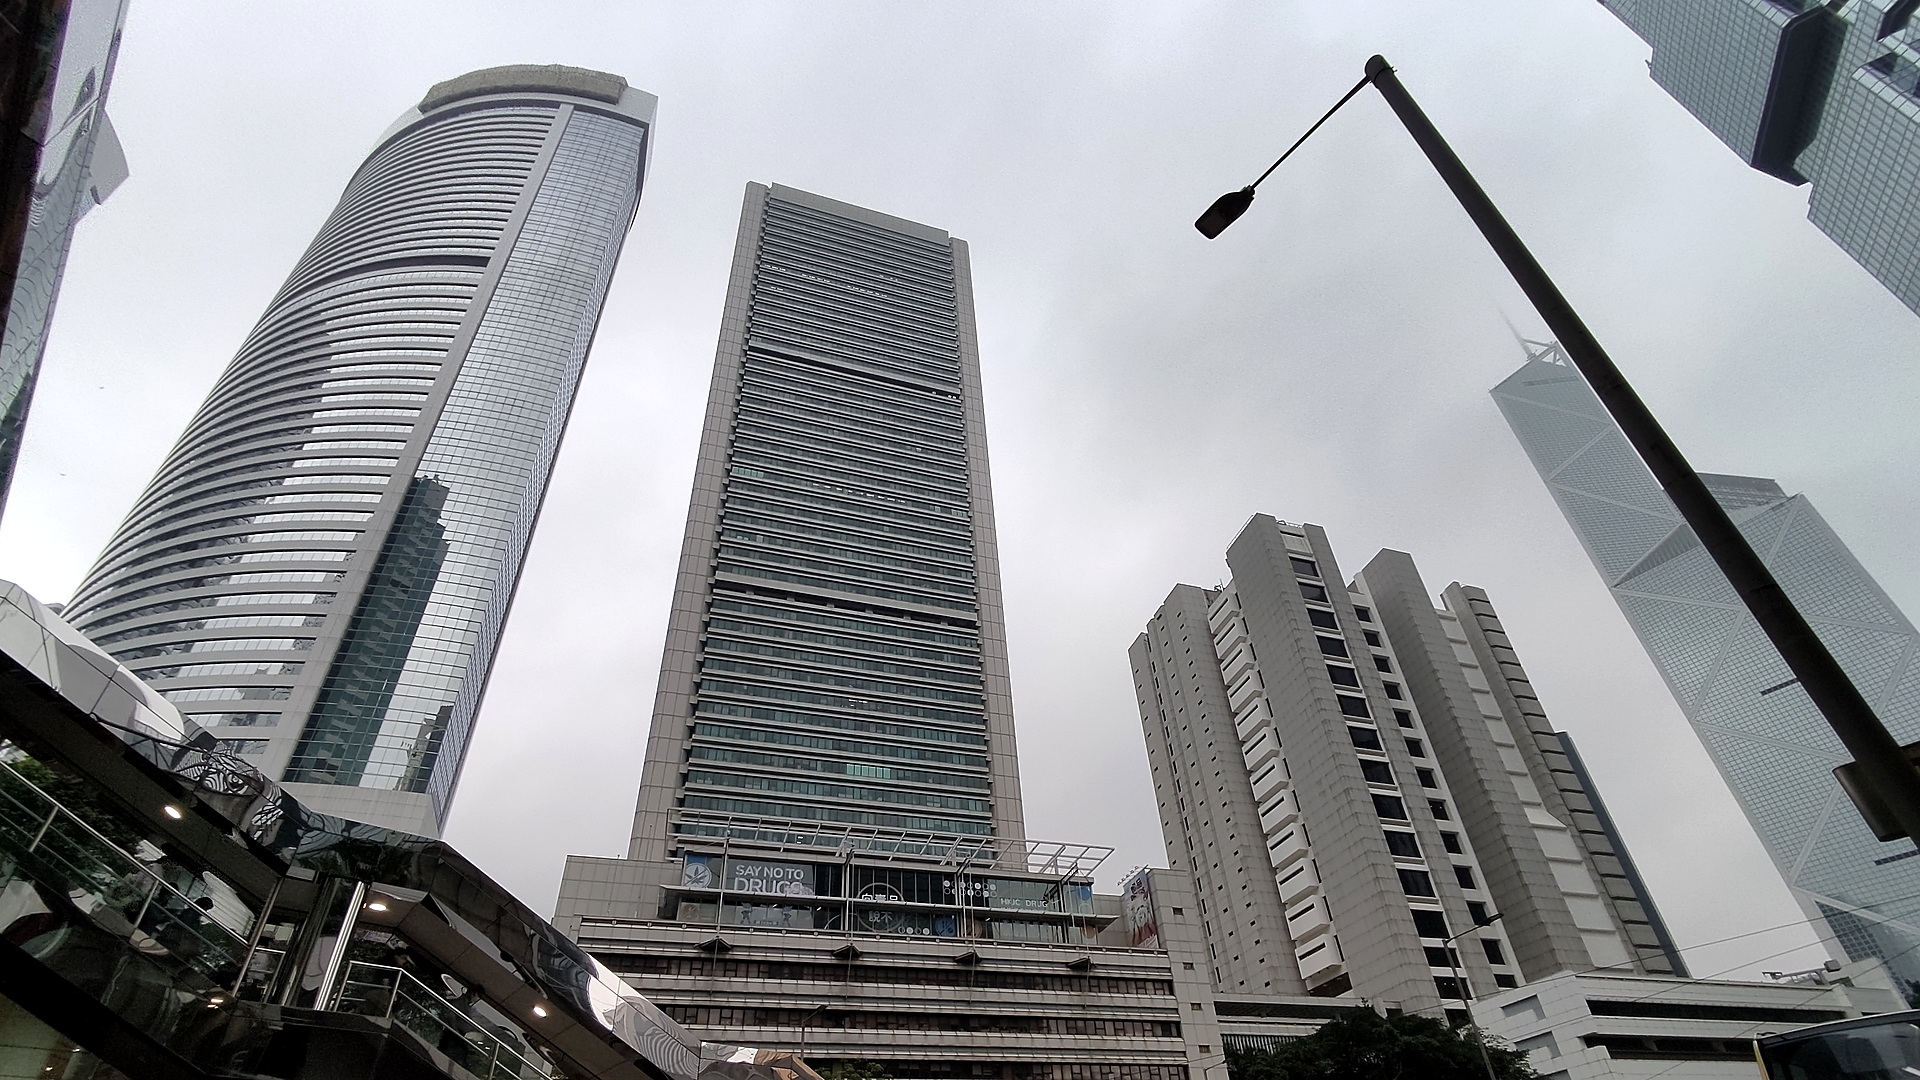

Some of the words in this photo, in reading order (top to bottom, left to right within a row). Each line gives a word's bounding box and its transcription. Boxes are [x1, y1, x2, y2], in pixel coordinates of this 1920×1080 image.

[735, 864, 762, 877] SAY
[763, 866, 784, 879] NO
[785, 867, 804, 881] TO
[1025, 899, 1048, 908] DRUG
